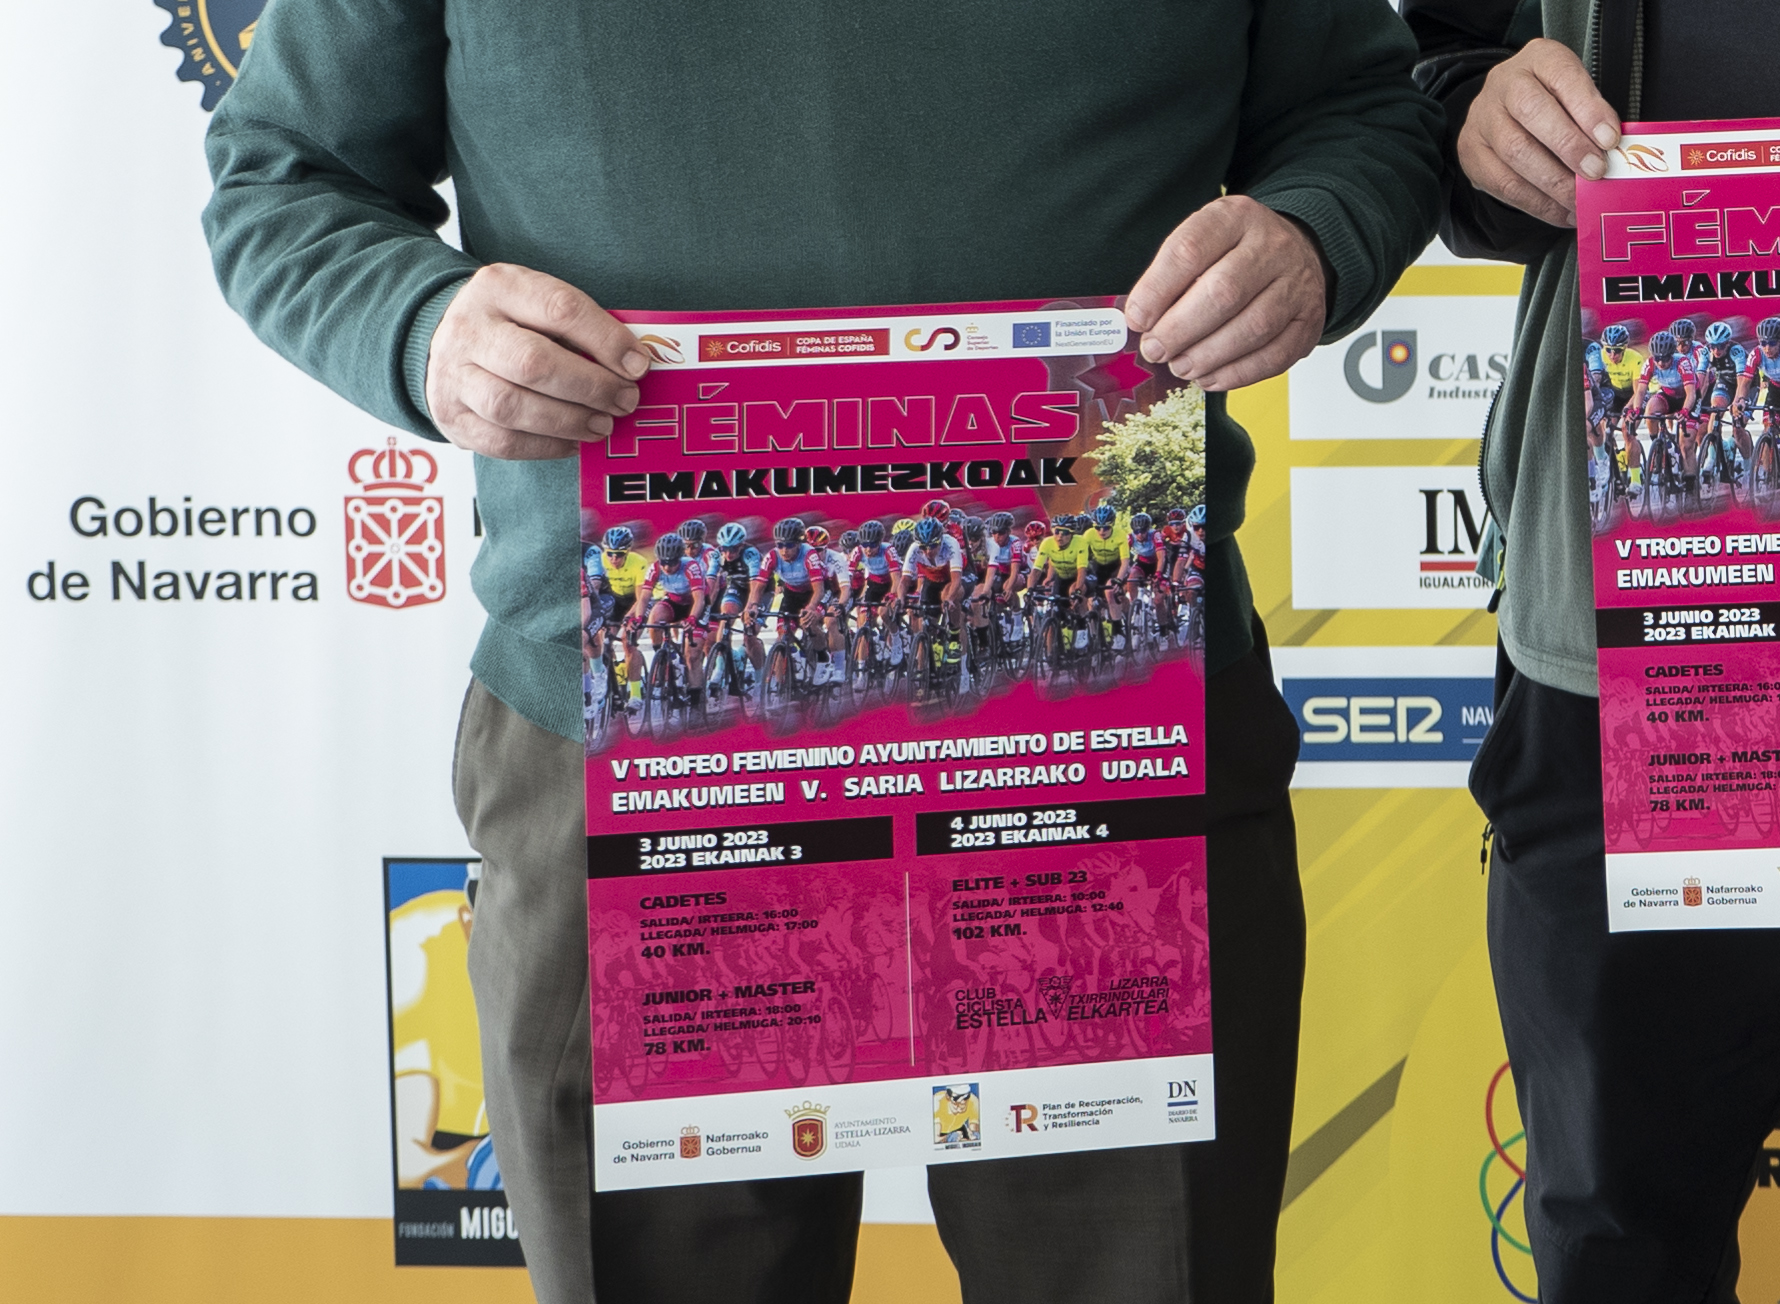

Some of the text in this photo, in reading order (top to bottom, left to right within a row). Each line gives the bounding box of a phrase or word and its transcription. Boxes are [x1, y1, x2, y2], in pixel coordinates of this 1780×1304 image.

[1706, 148, 1757, 162] Cofidis
[726, 339, 782, 355] Cofidis
[1428, 353, 1509, 382] CAS
[606, 382, 1082, 459] FÉMINAS
[606, 455, 1079, 504] EMAKUMEZKOAK
[69, 495, 317, 538] Gobierno
[1419, 489, 1490, 555] IM
[1615, 539, 1632, 557] V
[1635, 535, 1721, 556] TROFEO
[27, 560, 319, 602] de Navarra
[1617, 563, 1773, 587] EMAKUMEEN
[1643, 607, 1760, 625] 3 JUNIO 2023
[1643, 626, 1686, 641] 2023
[1690, 623, 1776, 639] EKAINAK
[1643, 662, 1724, 679] CADETES
[1302, 696, 1494, 744] SER NAV
[1646, 708, 1710, 724] 40 KM.
[610, 724, 1187, 778] V TROFEO FEMENINO AYUNTAMIENTO DE ESTELLA
[1647, 751, 1712, 767] JUNIOR
[612, 756, 1188, 811] EMAKUMEEN V. SARIA LIZARRAKO UDALA
[1648, 797, 1711, 813] 78 KM.
[950, 809, 1076, 830] 4 JUNIO 2023
[639, 830, 768, 852] 3 JUNIO 2023
[951, 824, 1109, 847] 2023 EKAINAK 4
[640, 845, 802, 869] 2023 EKAINAK 3
[1631, 887, 1679, 898] Gobierno
[1706, 884, 1764, 895] Nafarroako
[1706, 895, 1758, 906] Gobernua
[1623, 897, 1680, 909] de Navarra
